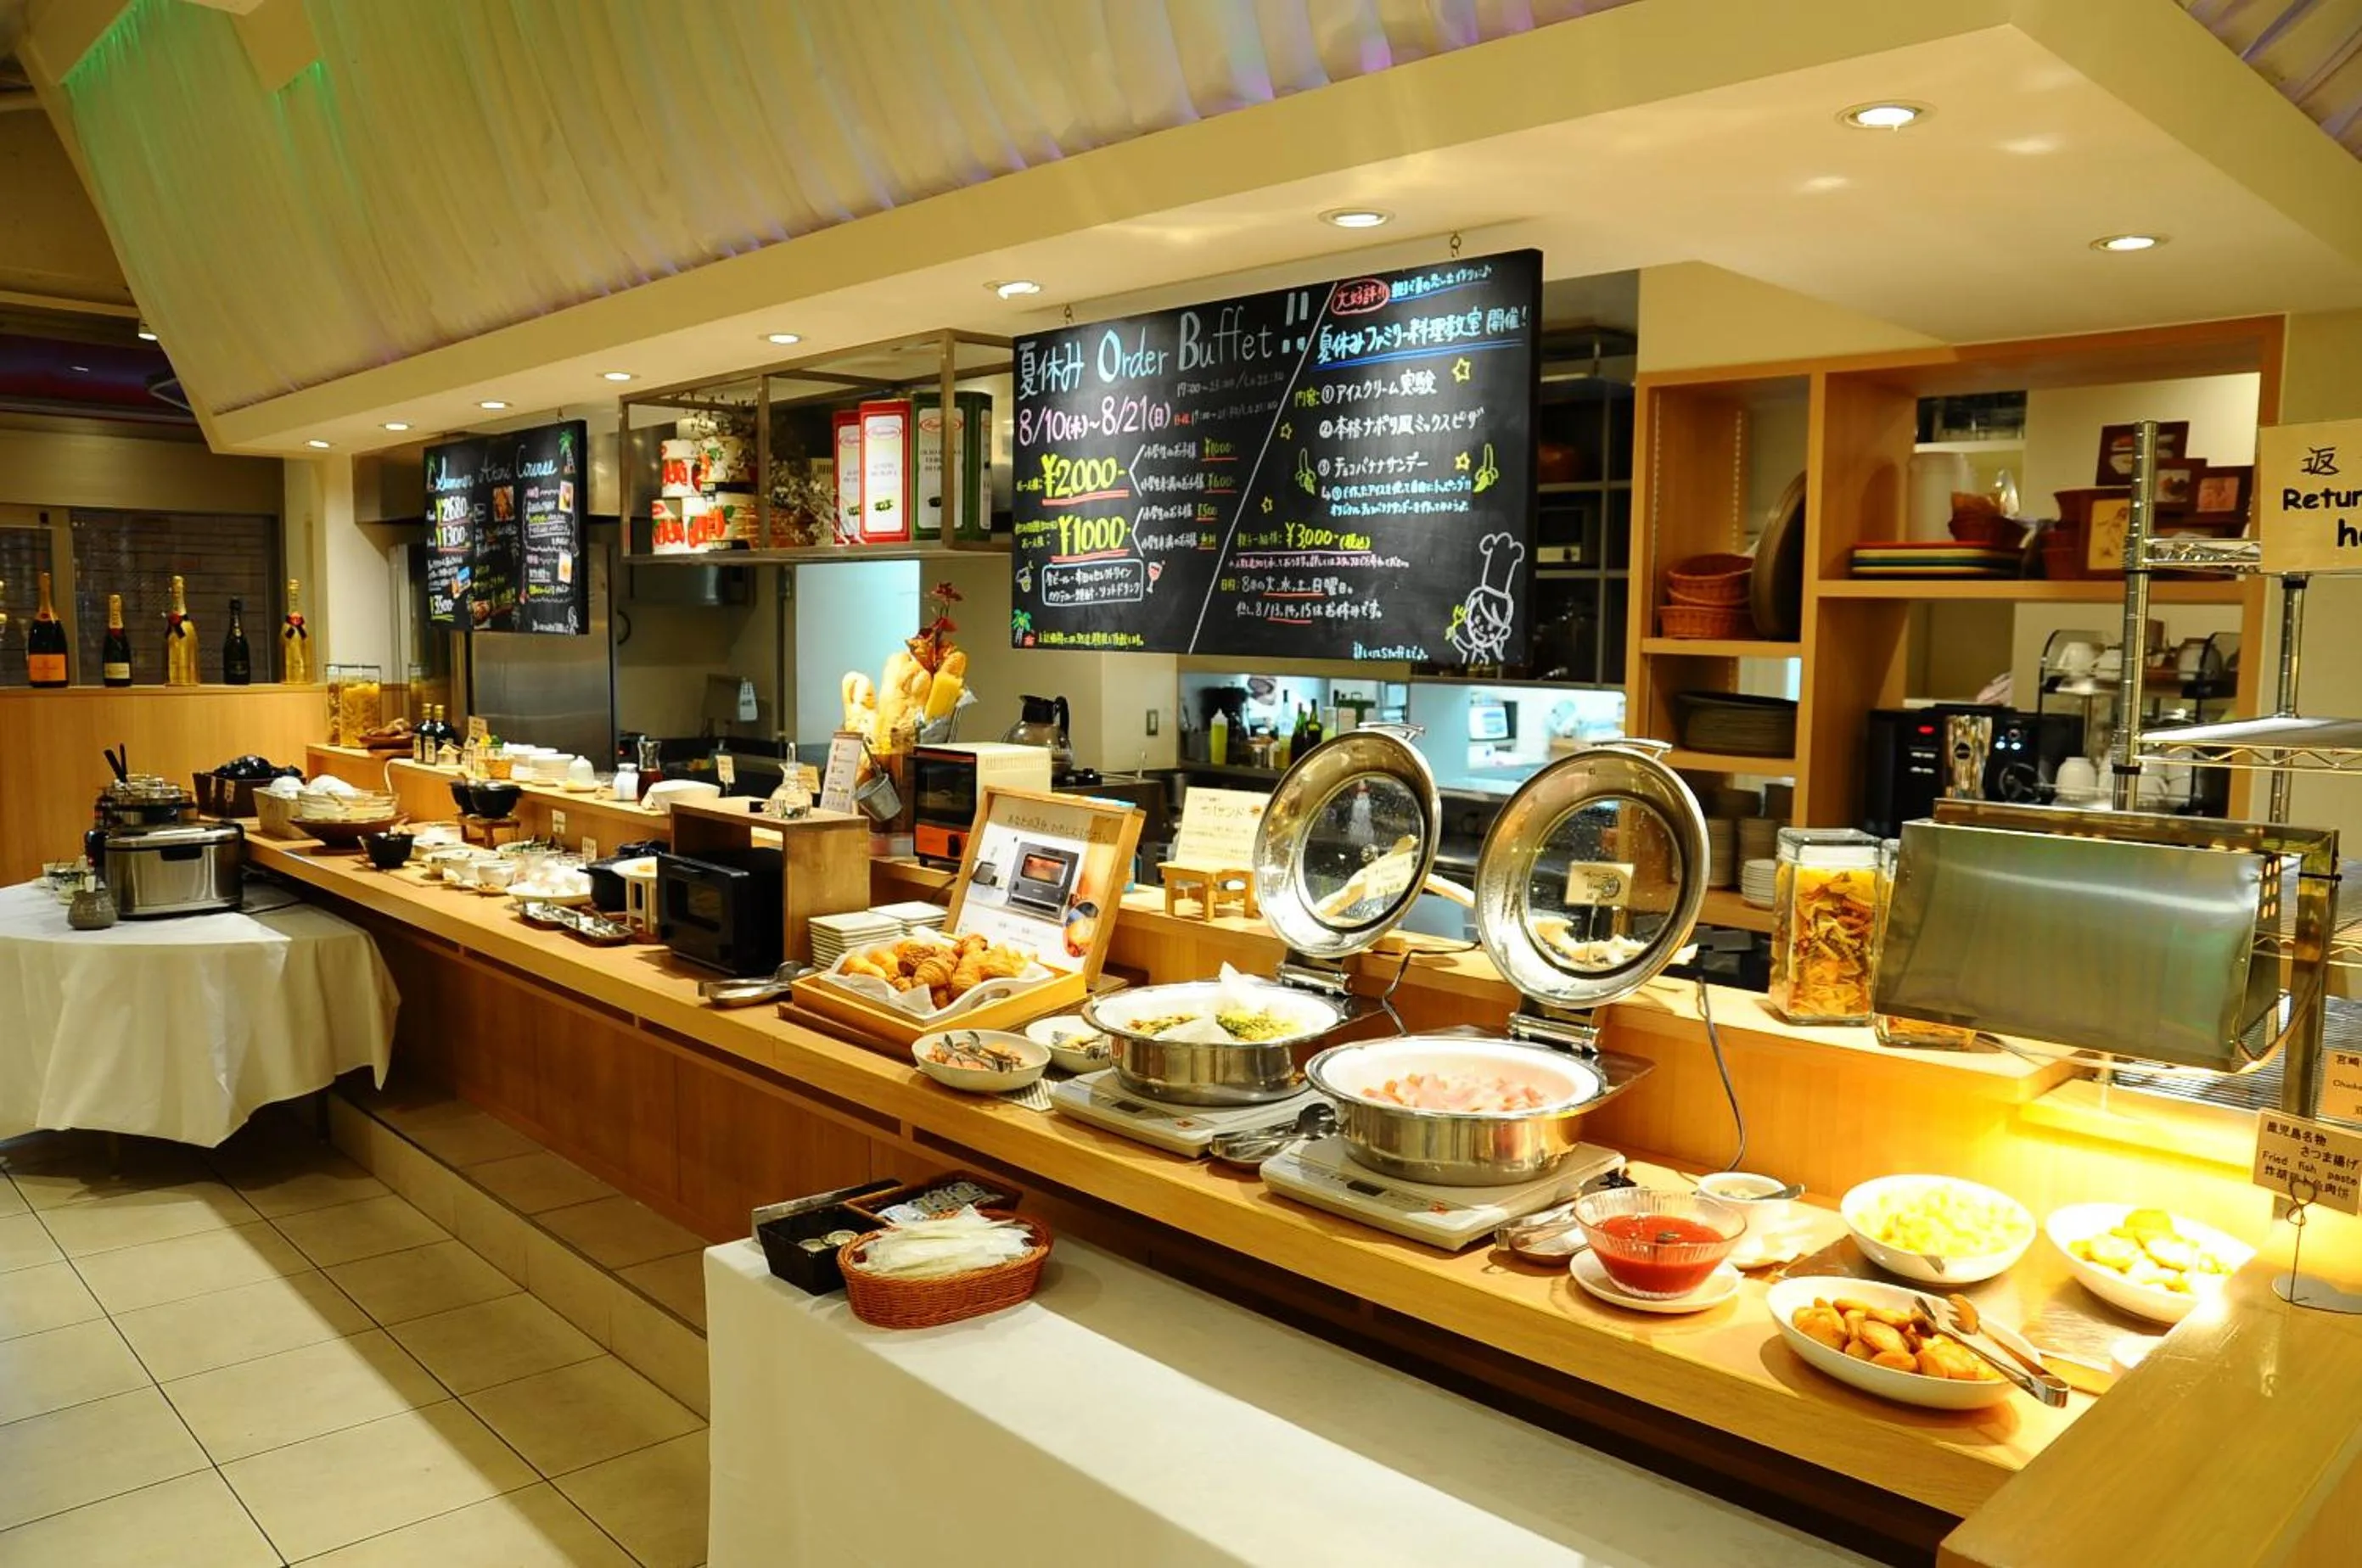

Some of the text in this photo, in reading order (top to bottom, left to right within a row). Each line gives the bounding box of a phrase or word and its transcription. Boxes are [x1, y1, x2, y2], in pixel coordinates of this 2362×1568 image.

[1018, 340, 1086, 400] 夏休み
[1097, 327, 1169, 383] Order
[1178, 305, 1273, 371] Buffet
[2301, 446, 2340, 476] 返
[2337, 518, 2362, 547] h
[2267, 1120, 2327, 1147] 鹿児島名物
[2262, 1150, 2289, 1165] Fried
[2326, 1172, 2358, 1185] paste
[2300, 1145, 2359, 1170] さつま揚げ
